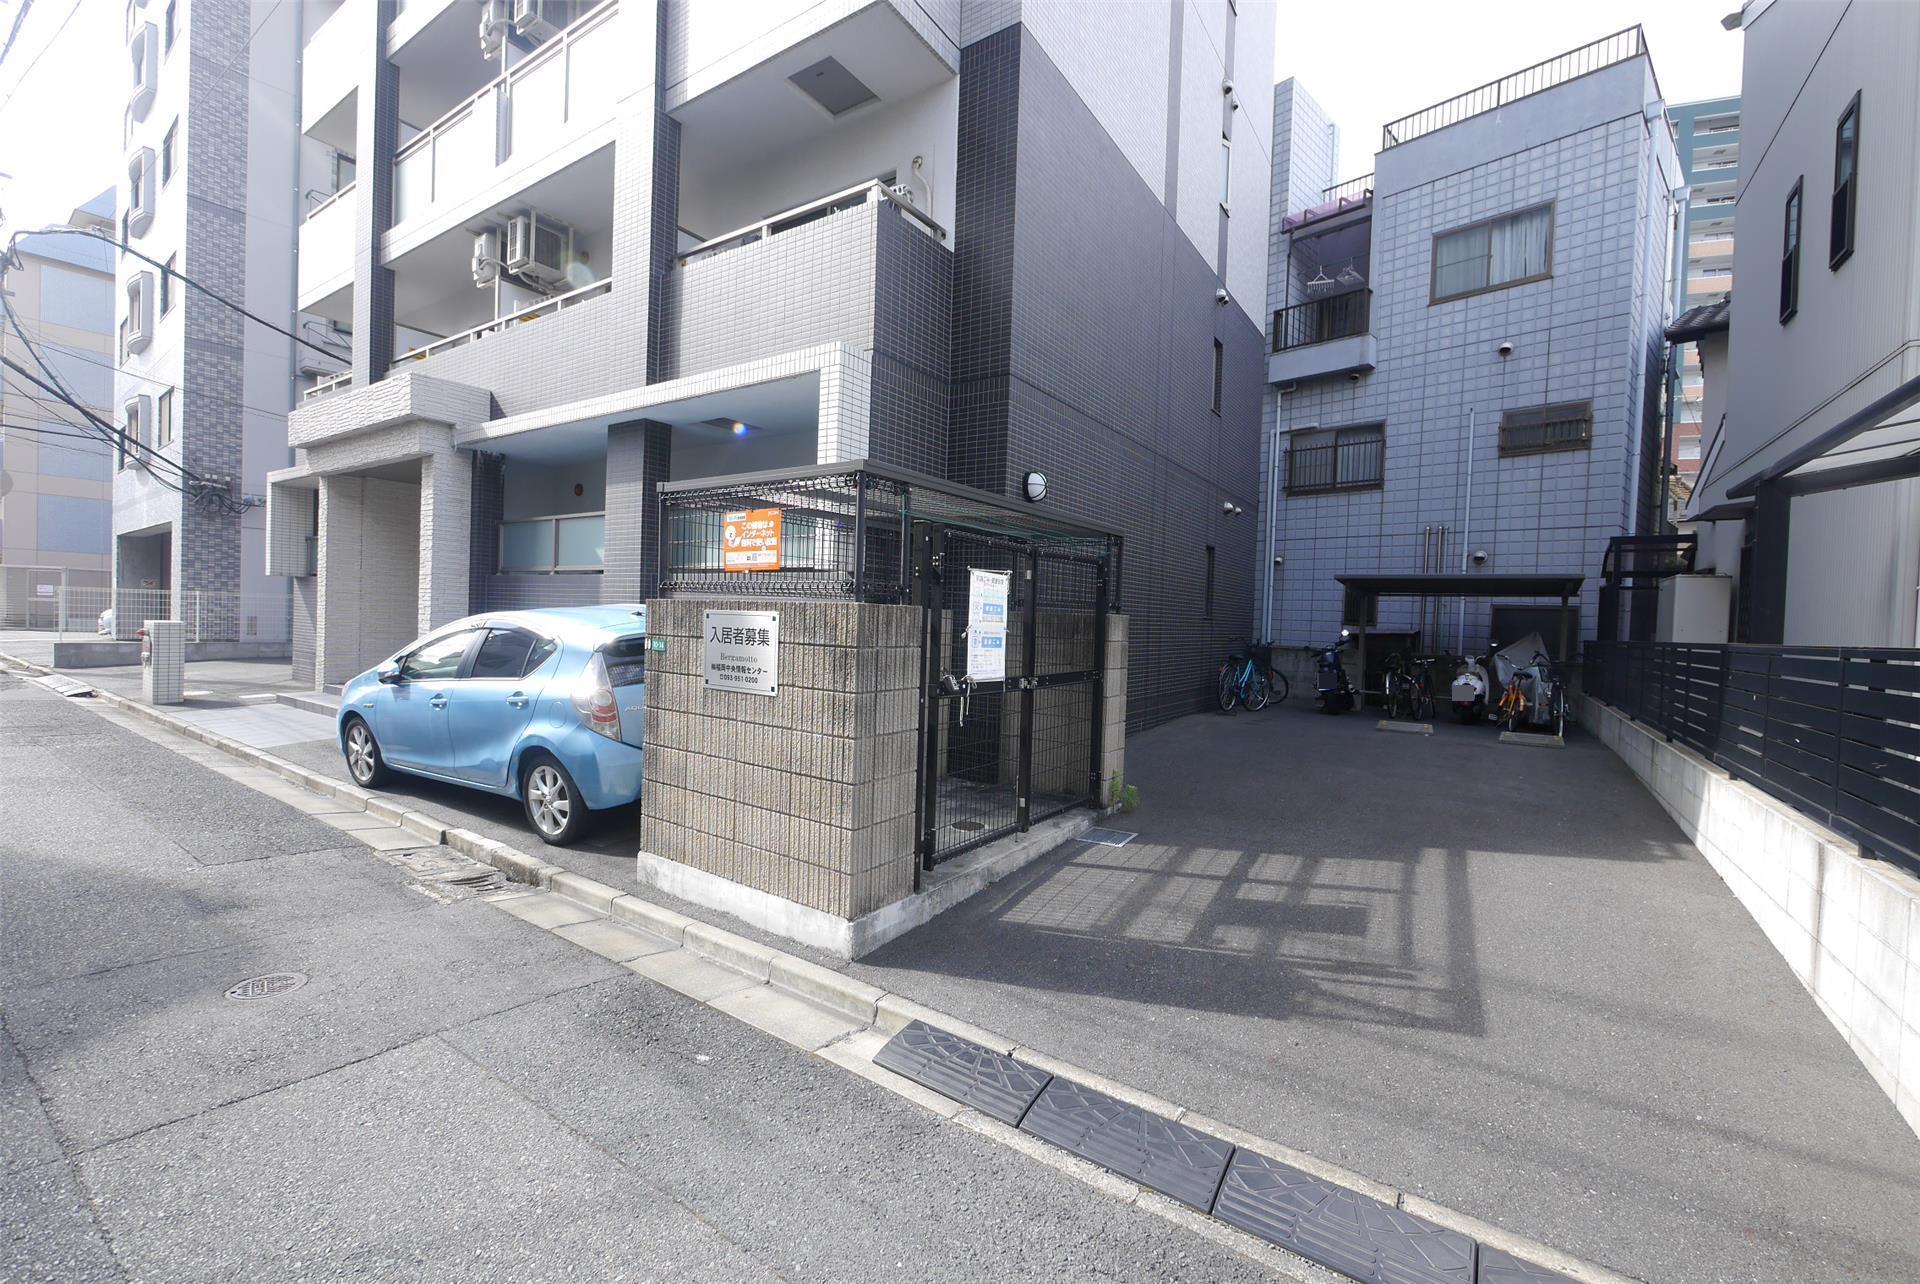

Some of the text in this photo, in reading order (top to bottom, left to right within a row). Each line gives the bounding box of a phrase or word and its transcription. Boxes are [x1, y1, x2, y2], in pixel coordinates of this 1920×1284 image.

[742, 529, 775, 538] インターネット
[710, 626, 770, 647] 入居者募集
[720, 652, 758, 663] Bergamotto
